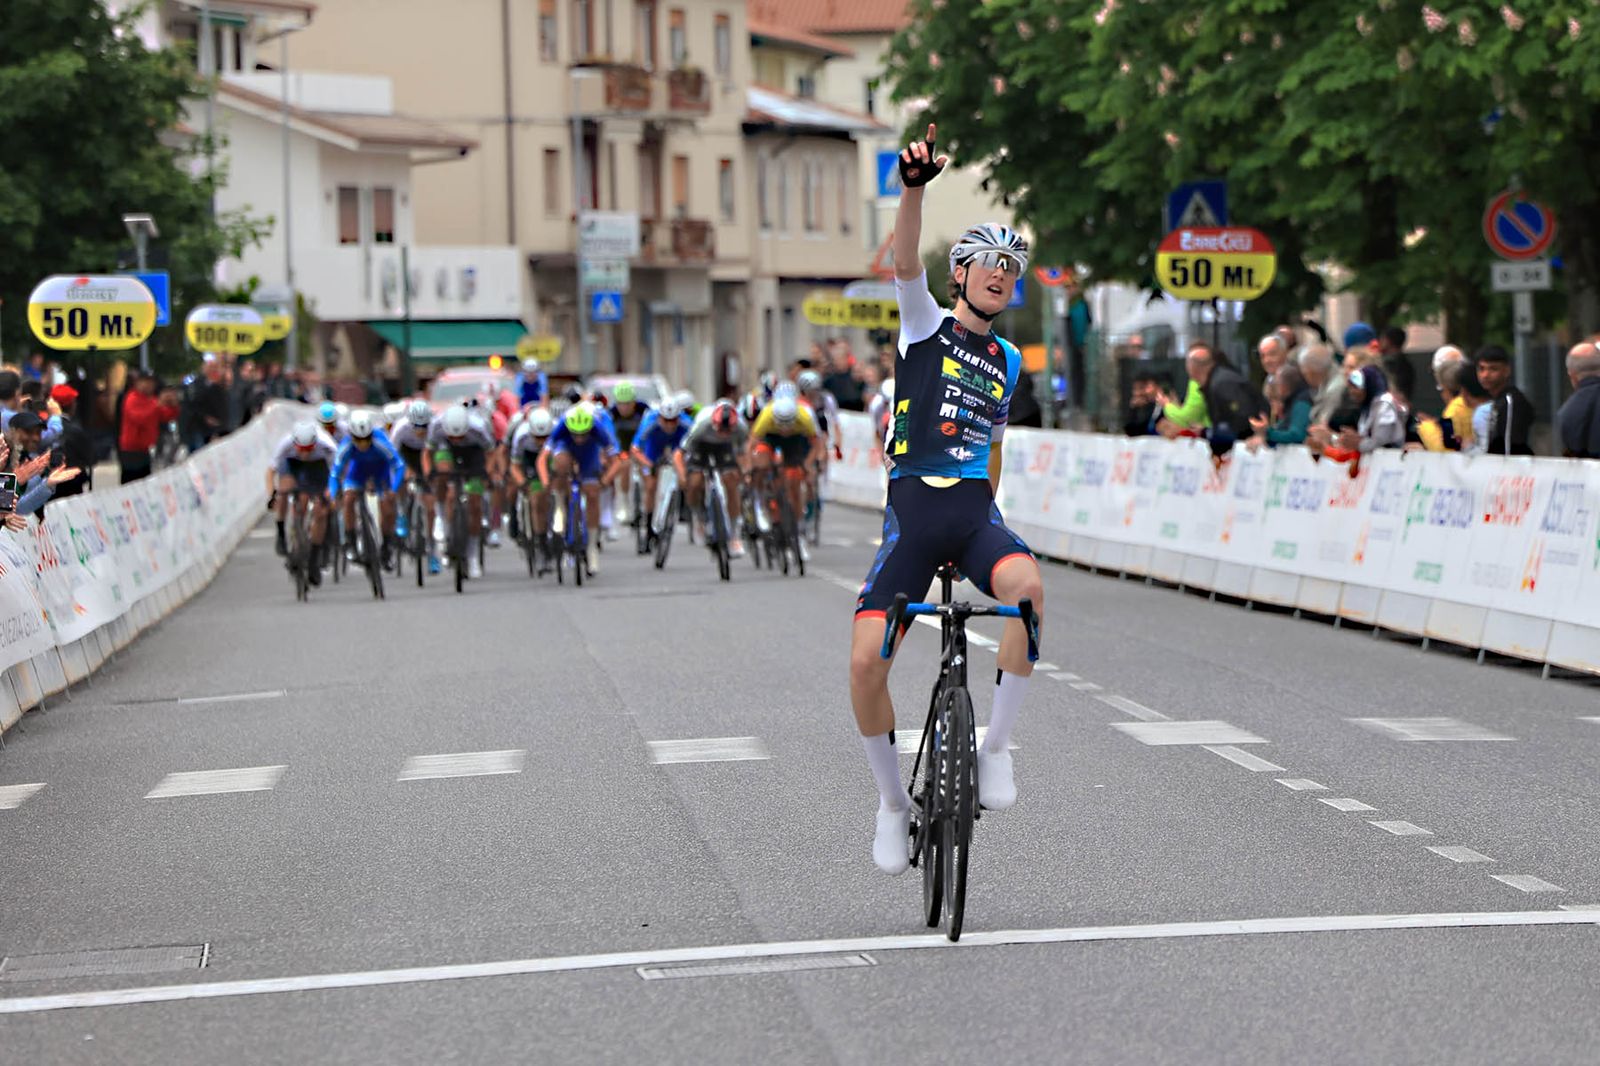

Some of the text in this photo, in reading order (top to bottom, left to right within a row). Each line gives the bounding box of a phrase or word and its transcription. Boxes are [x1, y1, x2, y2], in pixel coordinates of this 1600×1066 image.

[1169, 258, 1262, 289] 50 Mt.
[42, 307, 142, 339] 50 Mt.
[194, 326, 229, 344] 100
